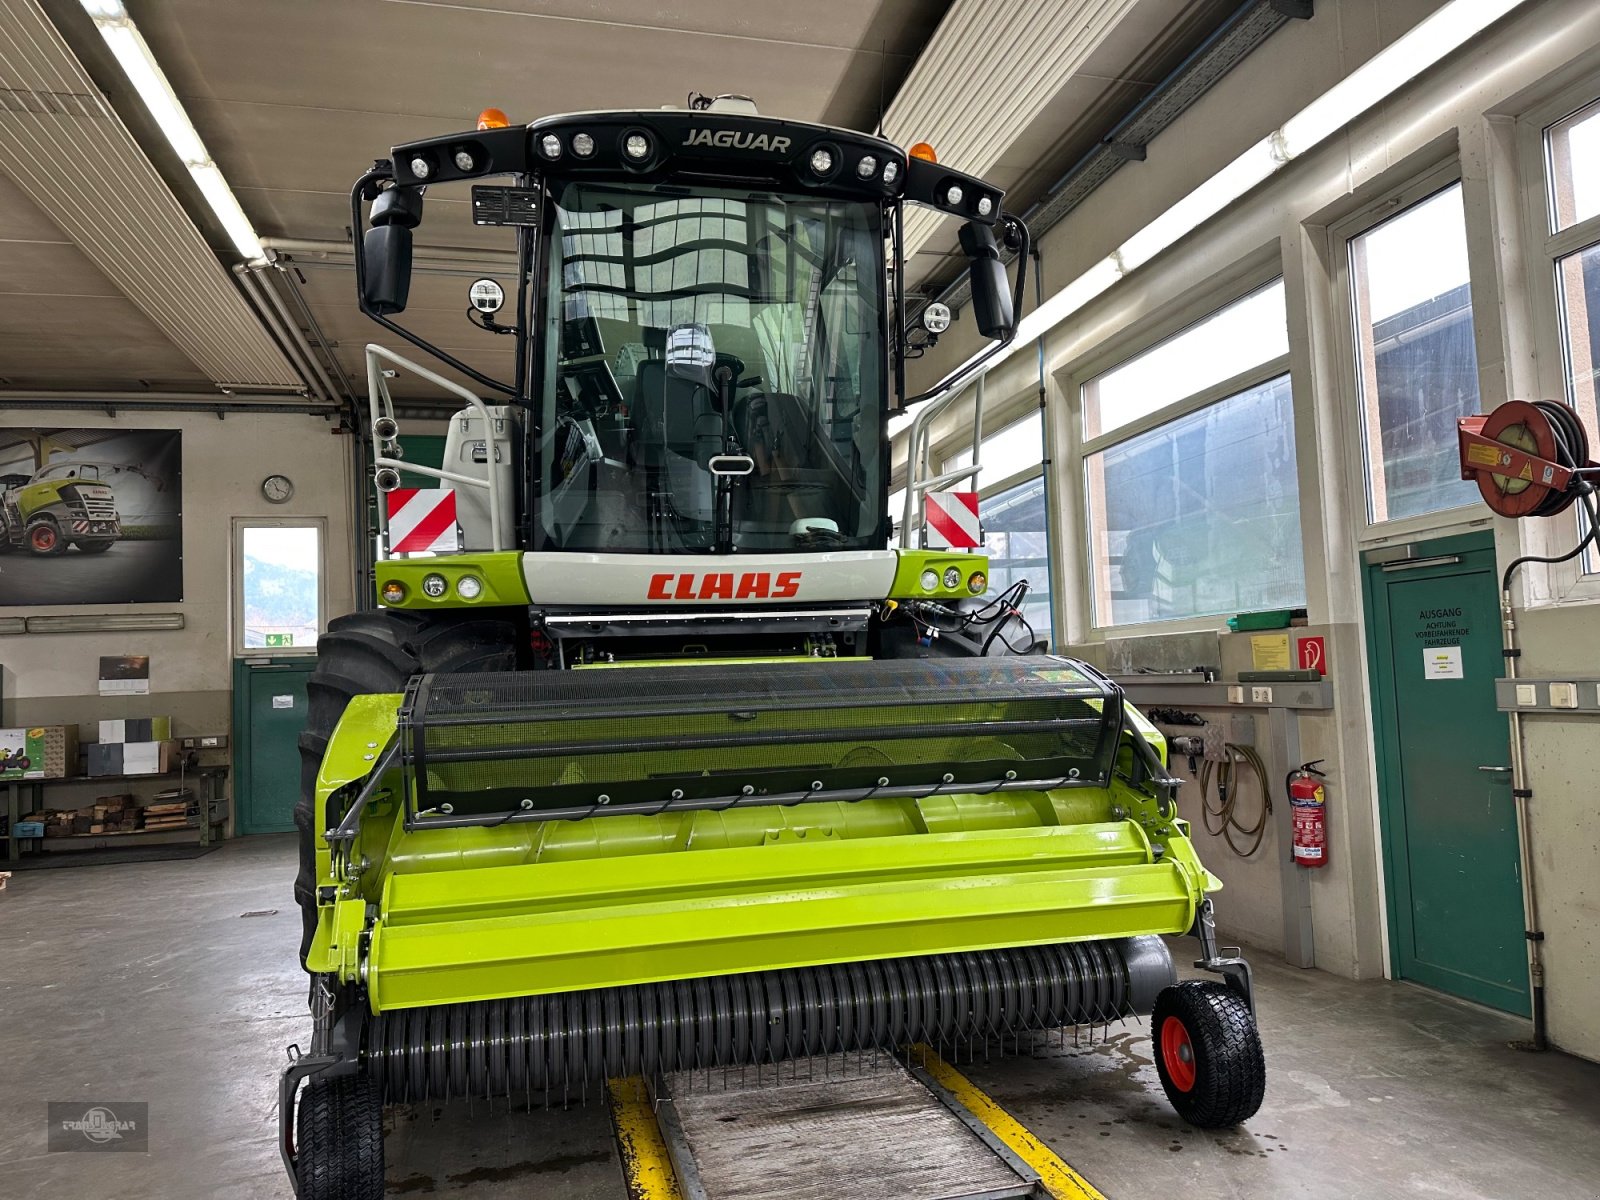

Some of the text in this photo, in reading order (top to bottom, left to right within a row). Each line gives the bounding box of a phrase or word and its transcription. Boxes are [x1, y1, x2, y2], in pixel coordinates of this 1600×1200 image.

[682, 129, 791, 153] JAGUAR
[647, 572, 802, 600] CLAAS
[1419, 608, 1462, 620] AUSGANG
[1426, 621, 1456, 630] ACHTUNG
[1415, 628, 1470, 639] VORBEIFAHRENDE
[1425, 637, 1460, 646] FAHRZEUGE
